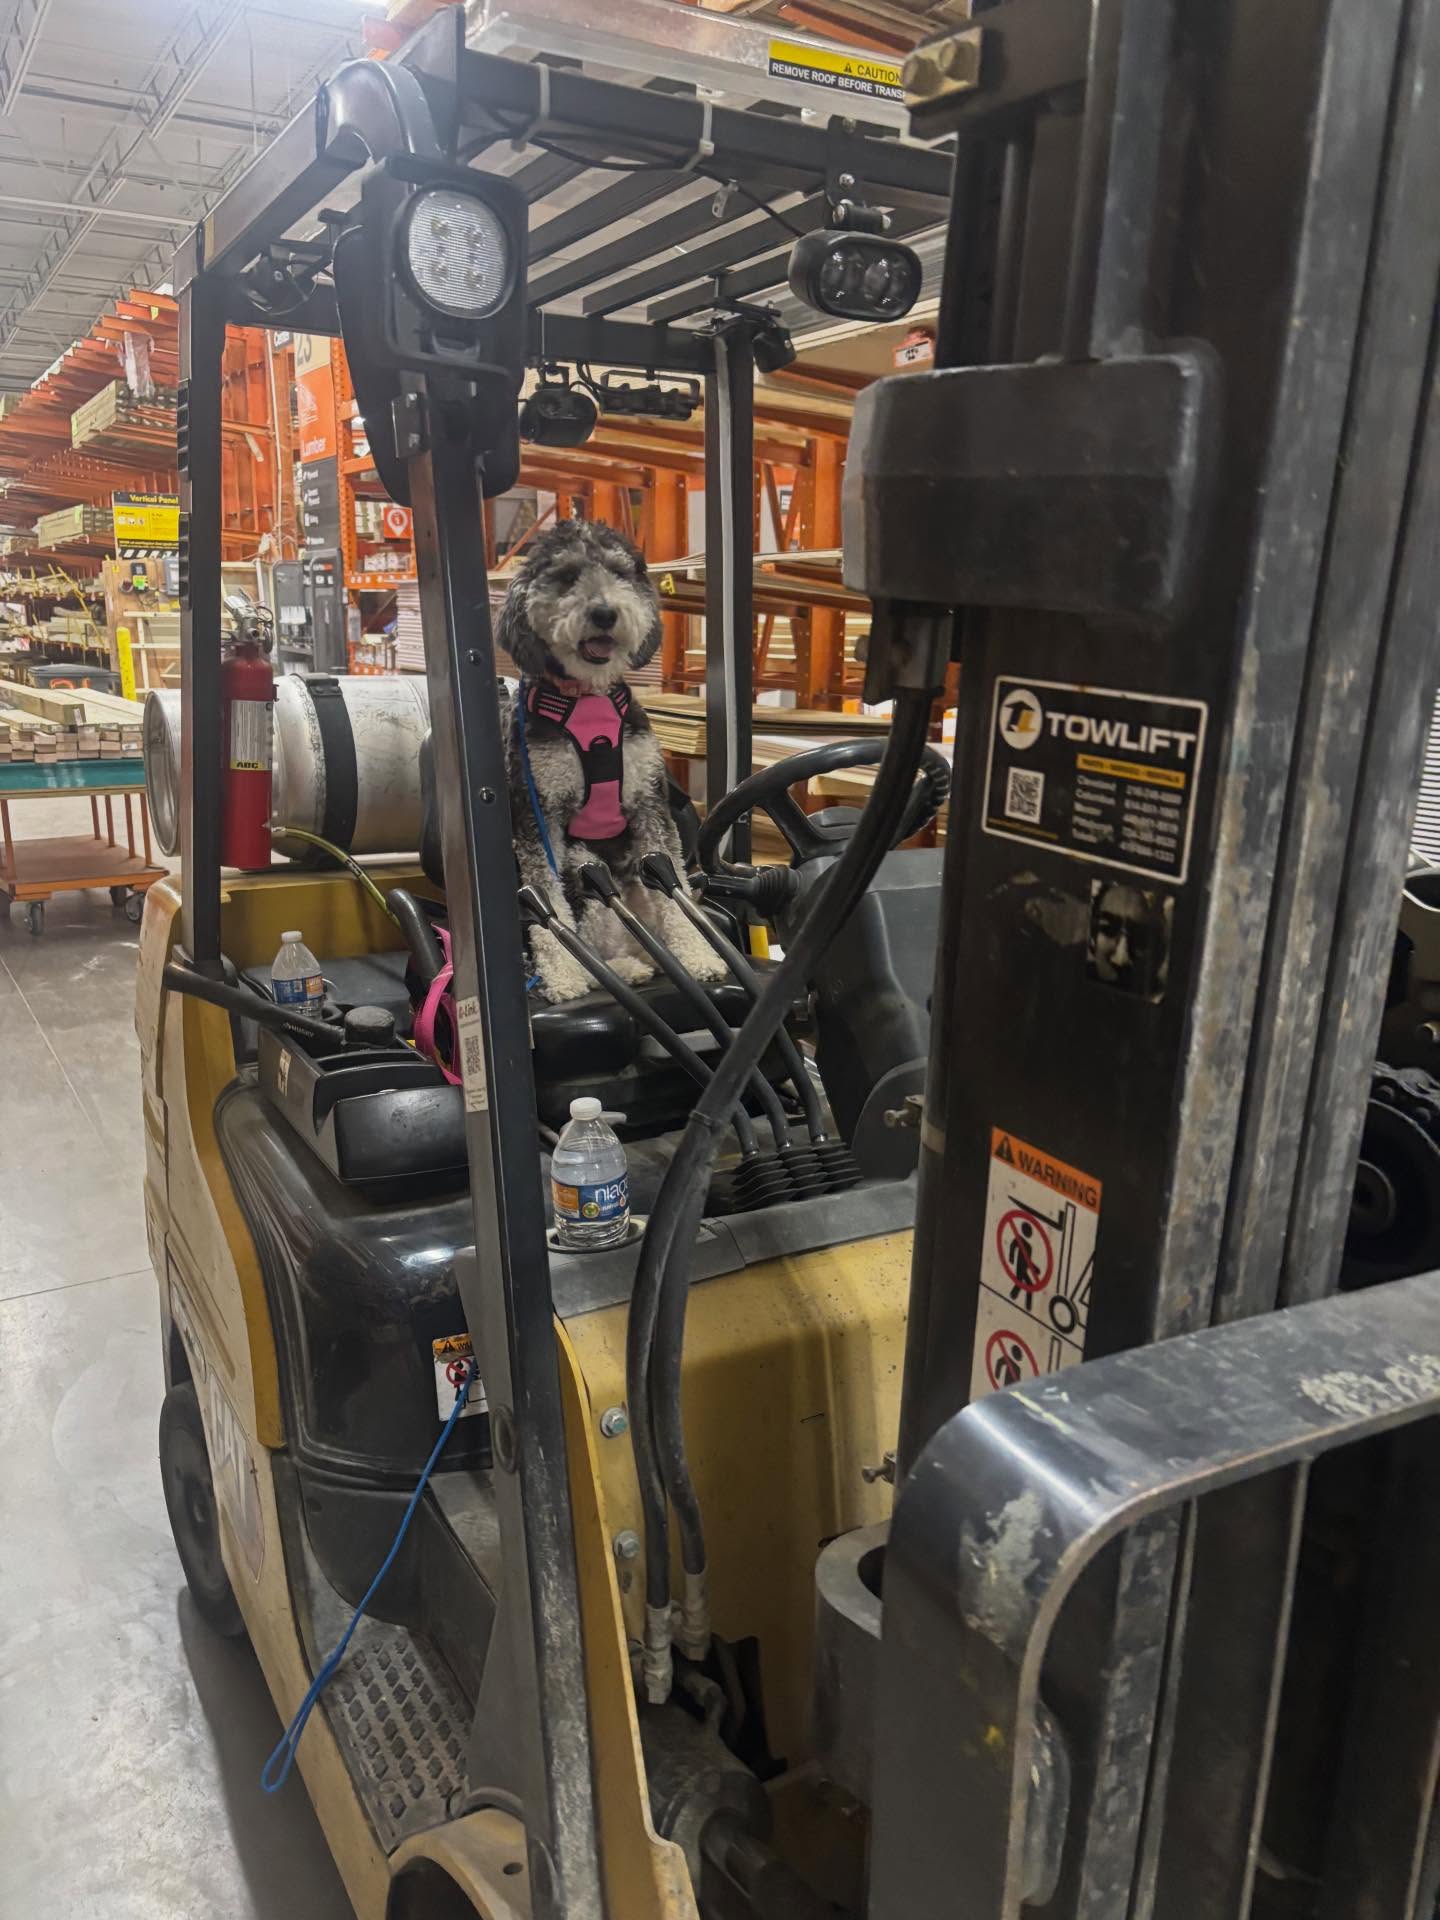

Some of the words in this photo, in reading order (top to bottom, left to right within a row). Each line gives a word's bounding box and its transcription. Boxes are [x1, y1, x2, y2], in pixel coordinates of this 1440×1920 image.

[773, 62, 809, 80] REMOVE
[812, 71, 836, 85] ROOF
[838, 76, 872, 93] BEFORE
[857, 64, 903, 83] CAUTION
[302, 436, 326, 457] Lumber
[130, 494, 157, 503] Vertical
[158, 495, 178, 504] Panel
[1045, 711, 1196, 759] TOWLIFT
[1018, 1150, 1097, 1207] WARNING
